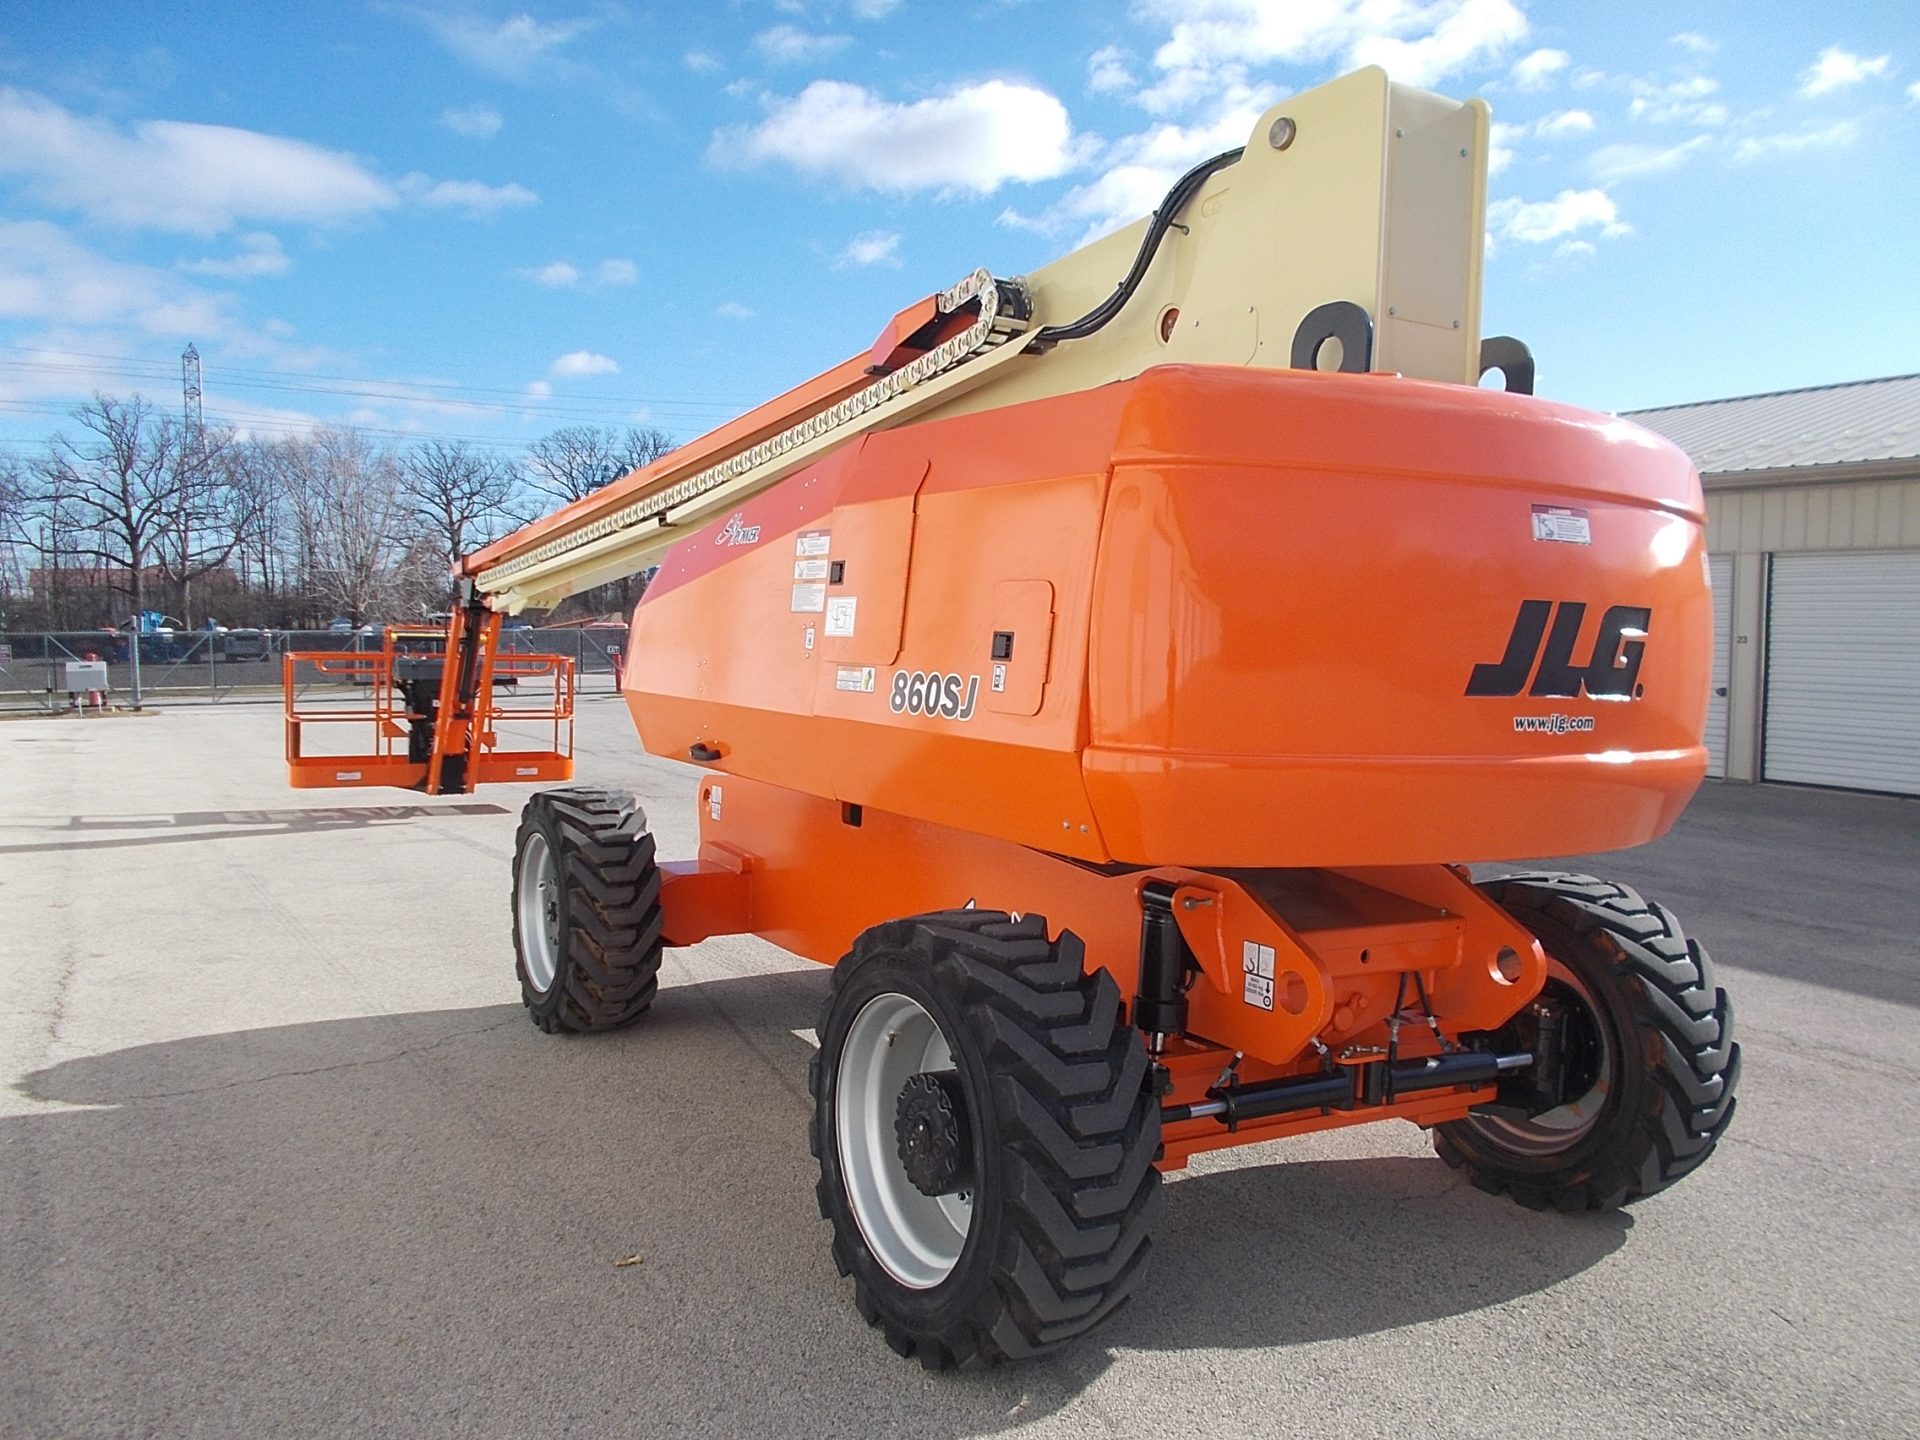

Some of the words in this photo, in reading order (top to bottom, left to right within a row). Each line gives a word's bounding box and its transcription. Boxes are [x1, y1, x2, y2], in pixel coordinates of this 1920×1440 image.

[1464, 599, 1652, 702] JLG
[1736, 635, 1749, 644] 23
[890, 670, 980, 721] 860SJ
[1513, 713, 1595, 735] www.jlg.com
